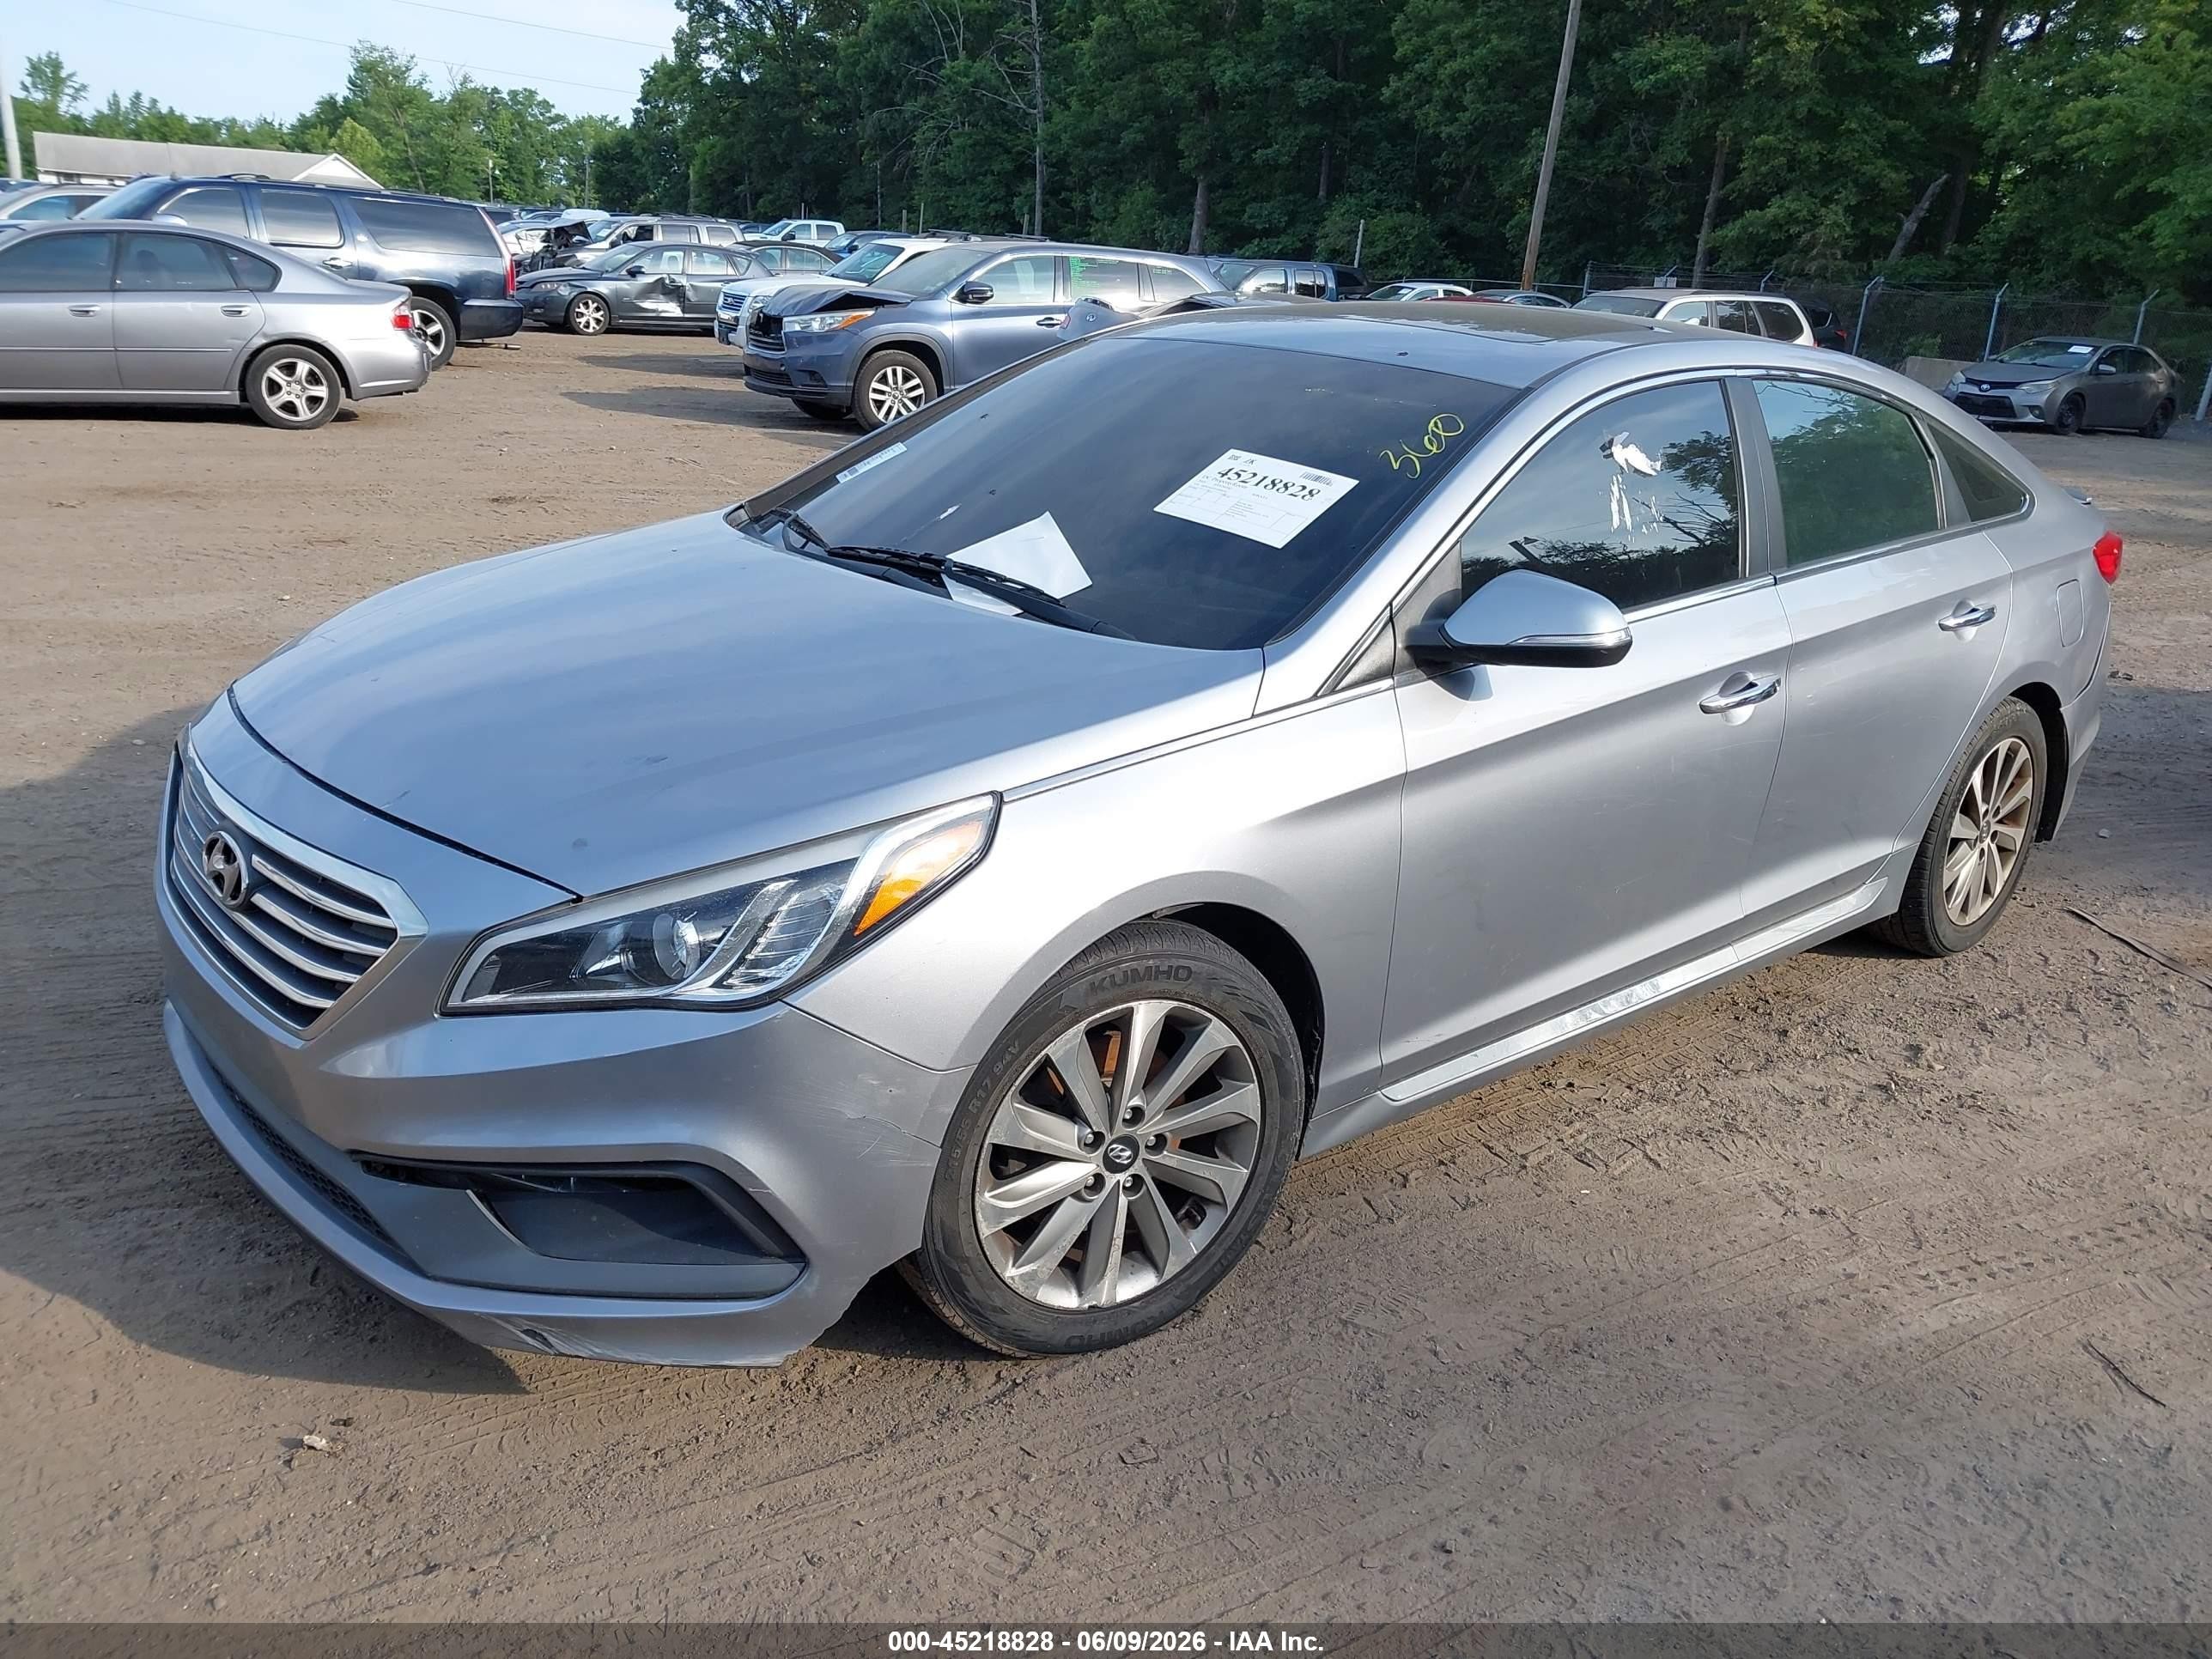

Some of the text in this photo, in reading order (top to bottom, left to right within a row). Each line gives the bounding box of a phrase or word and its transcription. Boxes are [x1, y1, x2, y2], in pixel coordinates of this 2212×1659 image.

[1217, 467, 1322, 501] 45218828
[1089, 965, 1193, 995] KUMHO
[968, 1079, 992, 1114] R17
[992, 1039, 1020, 1075] 94V
